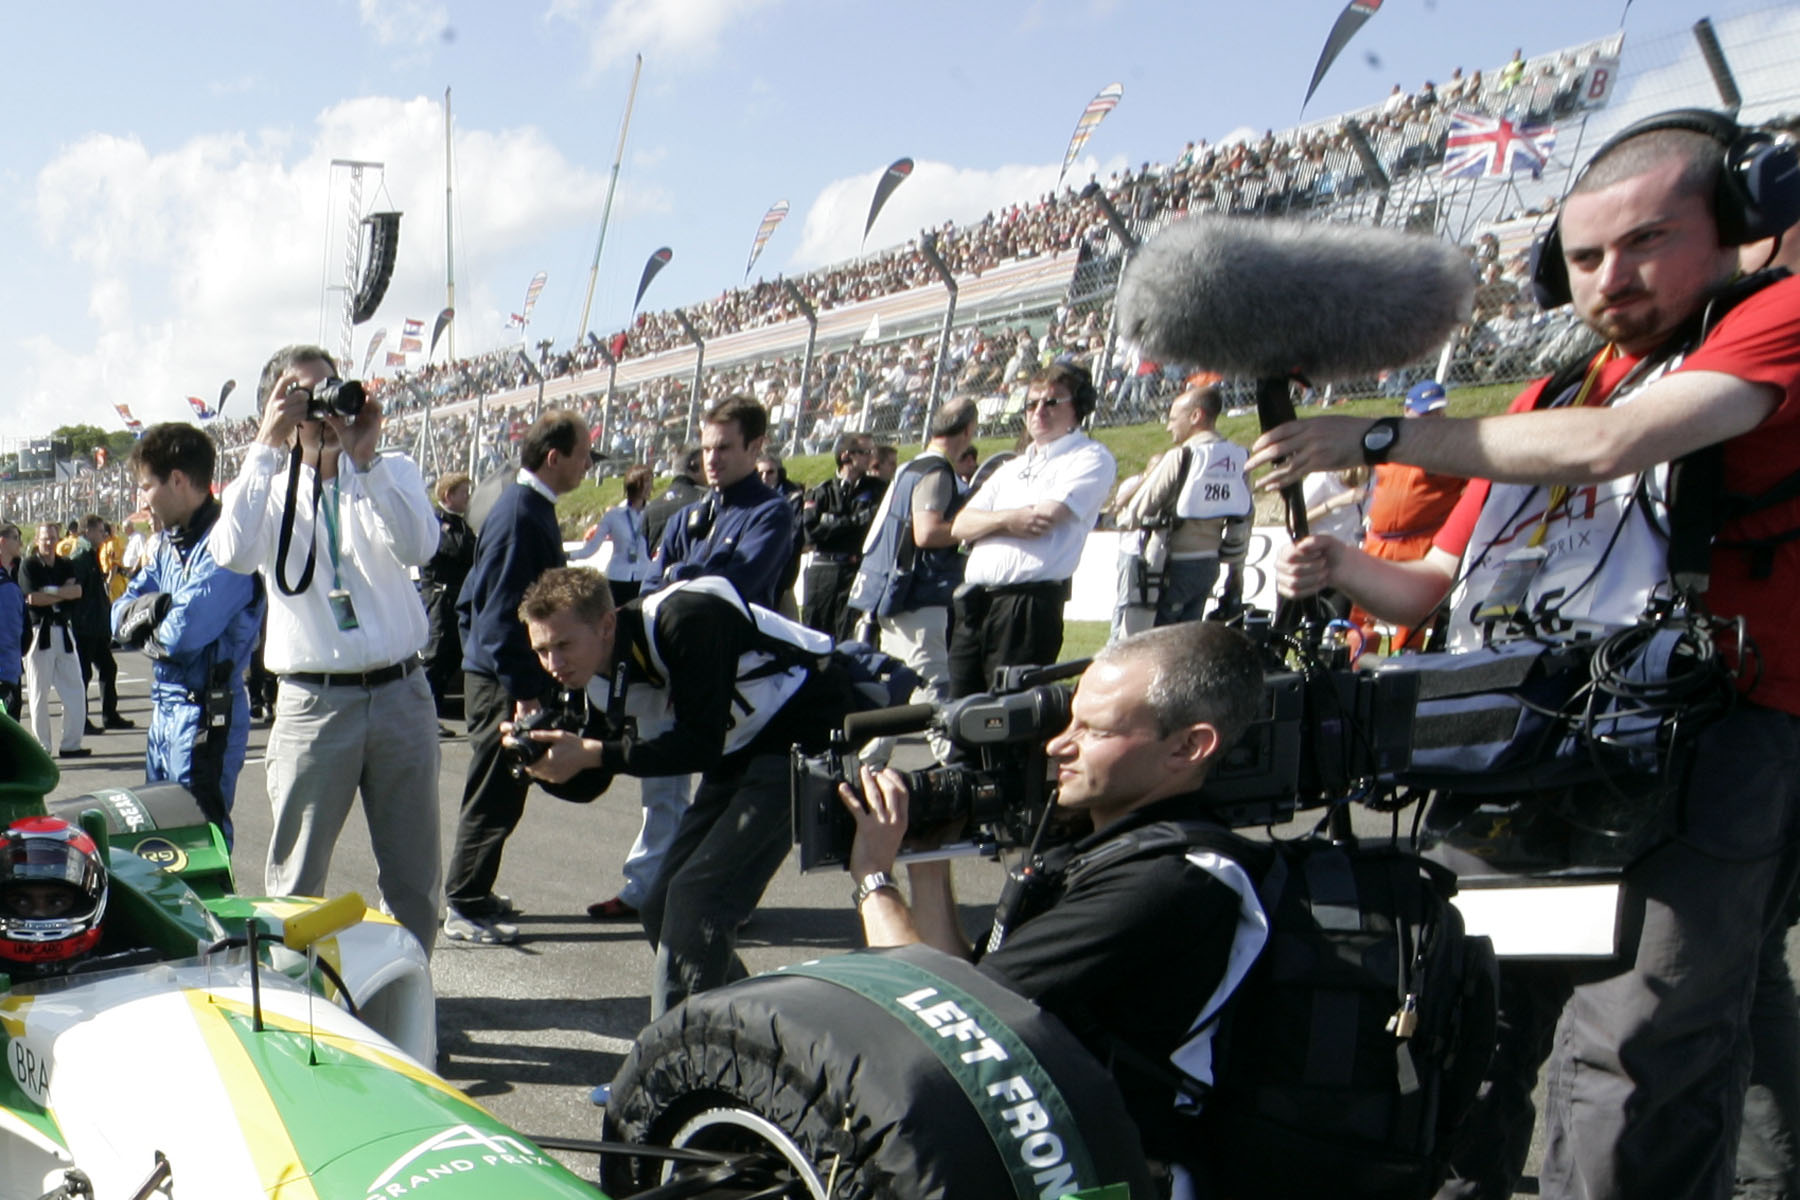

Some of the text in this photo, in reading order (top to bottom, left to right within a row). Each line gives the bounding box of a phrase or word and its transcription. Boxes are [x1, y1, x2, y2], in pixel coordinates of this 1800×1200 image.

[1588, 68, 1609, 99] B
[1203, 482, 1231, 501] 286
[895, 986, 1009, 1065] LEFT
[15, 1040, 52, 1104] BRA
[484, 1149, 552, 1168] PRIX
